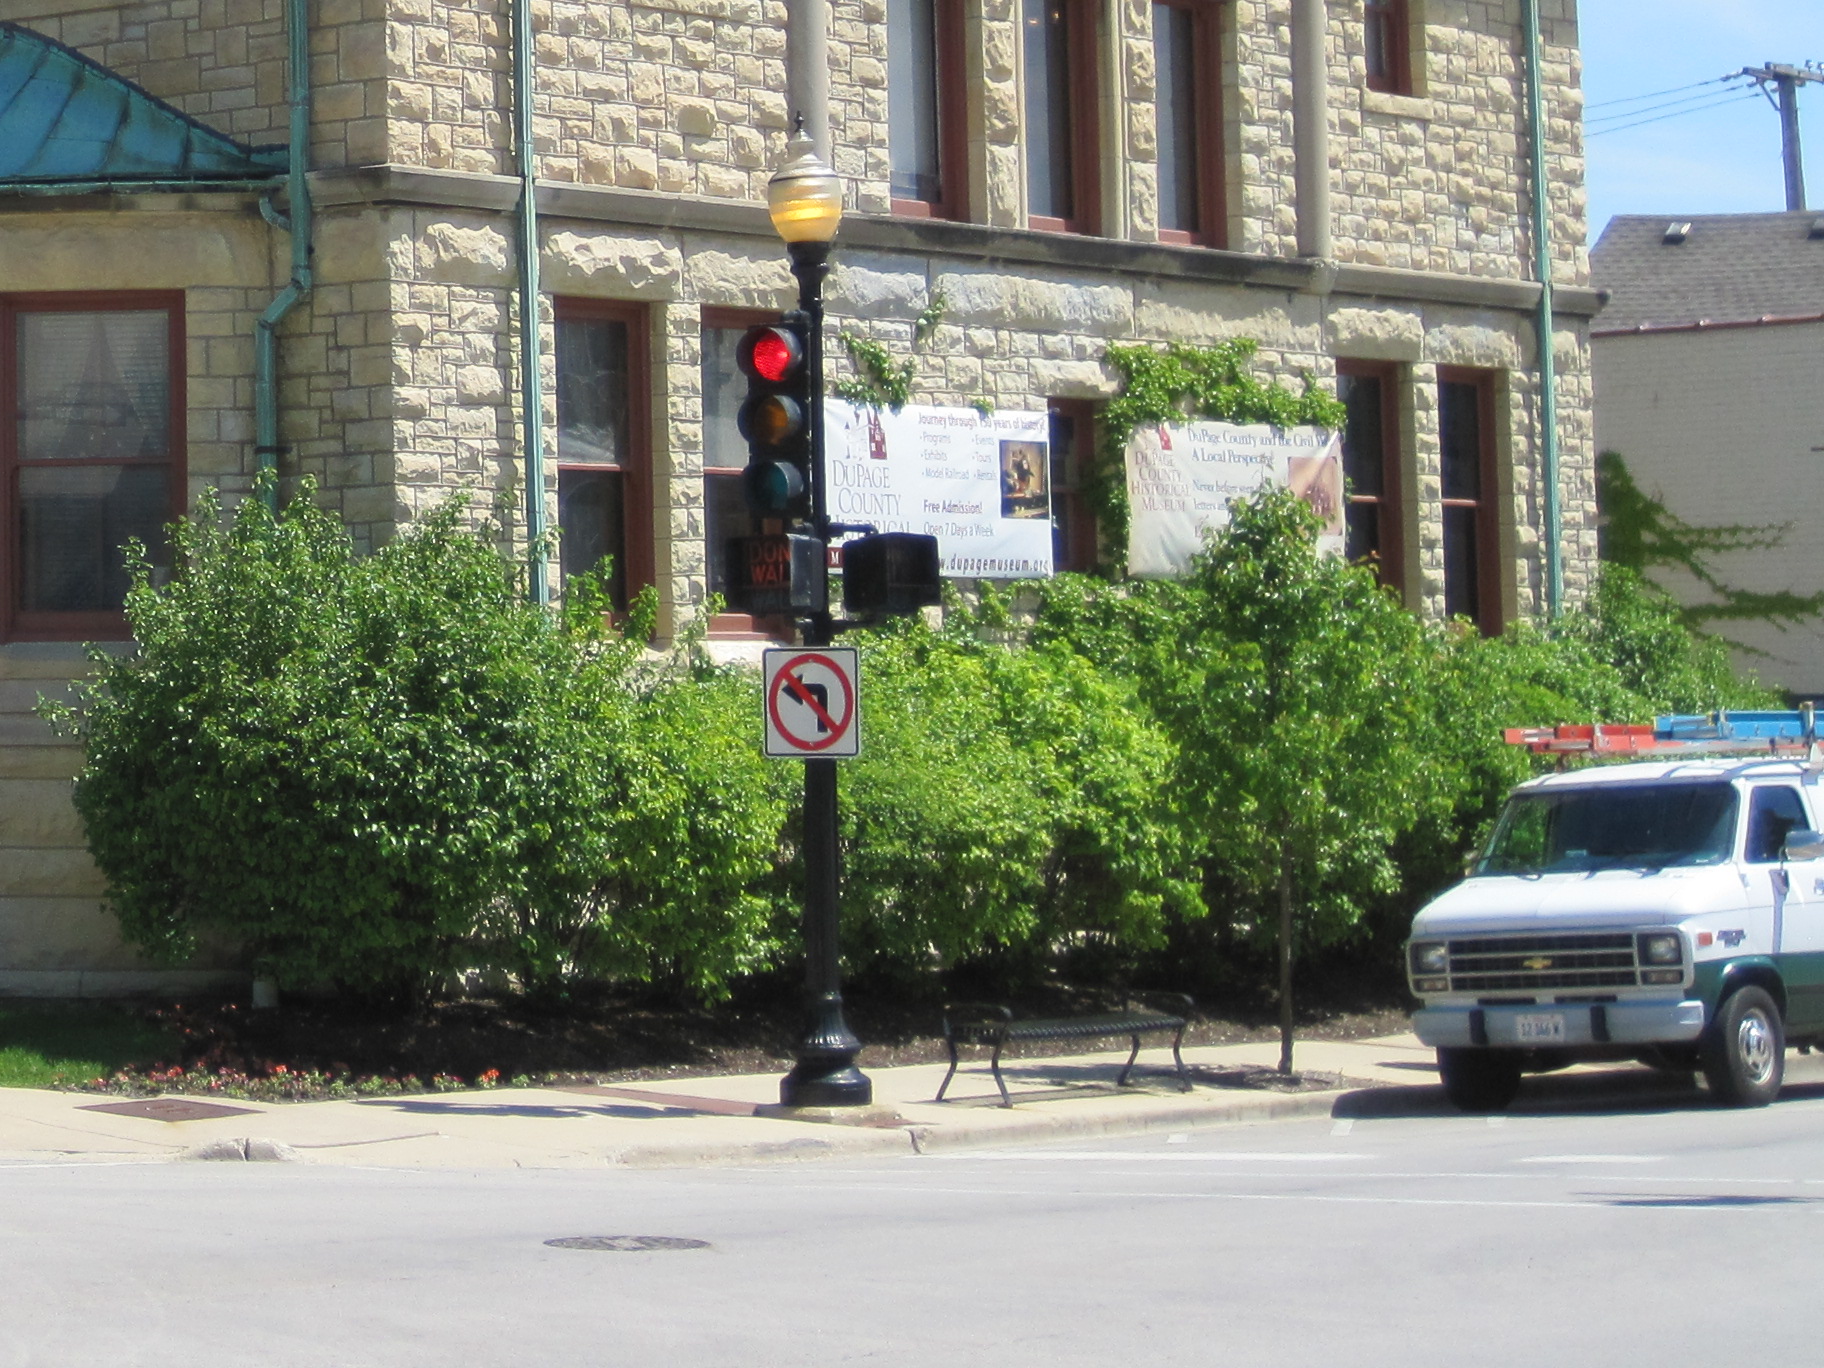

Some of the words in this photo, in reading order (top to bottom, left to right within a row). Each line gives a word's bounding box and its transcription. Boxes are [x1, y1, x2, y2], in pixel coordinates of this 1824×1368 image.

[918, 413, 947, 429] Journey
[948, 413, 978, 430] through
[993, 418, 1012, 431] years
[1013, 418, 1020, 429] of
[922, 432, 952, 446] Programs
[974, 434, 995, 446] Events
[1187, 428, 1221, 445] DuPage
[1223, 429, 1256, 447] County
[1259, 433, 1275, 446] and
[1276, 432, 1292, 446] the
[1293, 434, 1314, 447] Civil
[924, 449, 948, 462] Exhibits
[975, 451, 992, 463] Tours
[1191, 448, 1200, 462] A
[1201, 448, 1226, 463] Local
[926, 467, 944, 479] Model
[945, 468, 970, 480] Railroad
[1139, 467, 1182, 483] COUNTY
[1131, 480, 1191, 497] HISTORICAL
[1193, 479, 1215, 492] Never
[838, 487, 902, 515] COUNTY
[923, 499, 940, 513] Free
[941, 499, 983, 514] Admission!
[1142, 496, 1186, 512] MUSEUM
[923, 521, 944, 536] Open
[945, 522, 950, 536] 7
[951, 522, 968, 540] Days
[974, 523, 996, 537] Week
